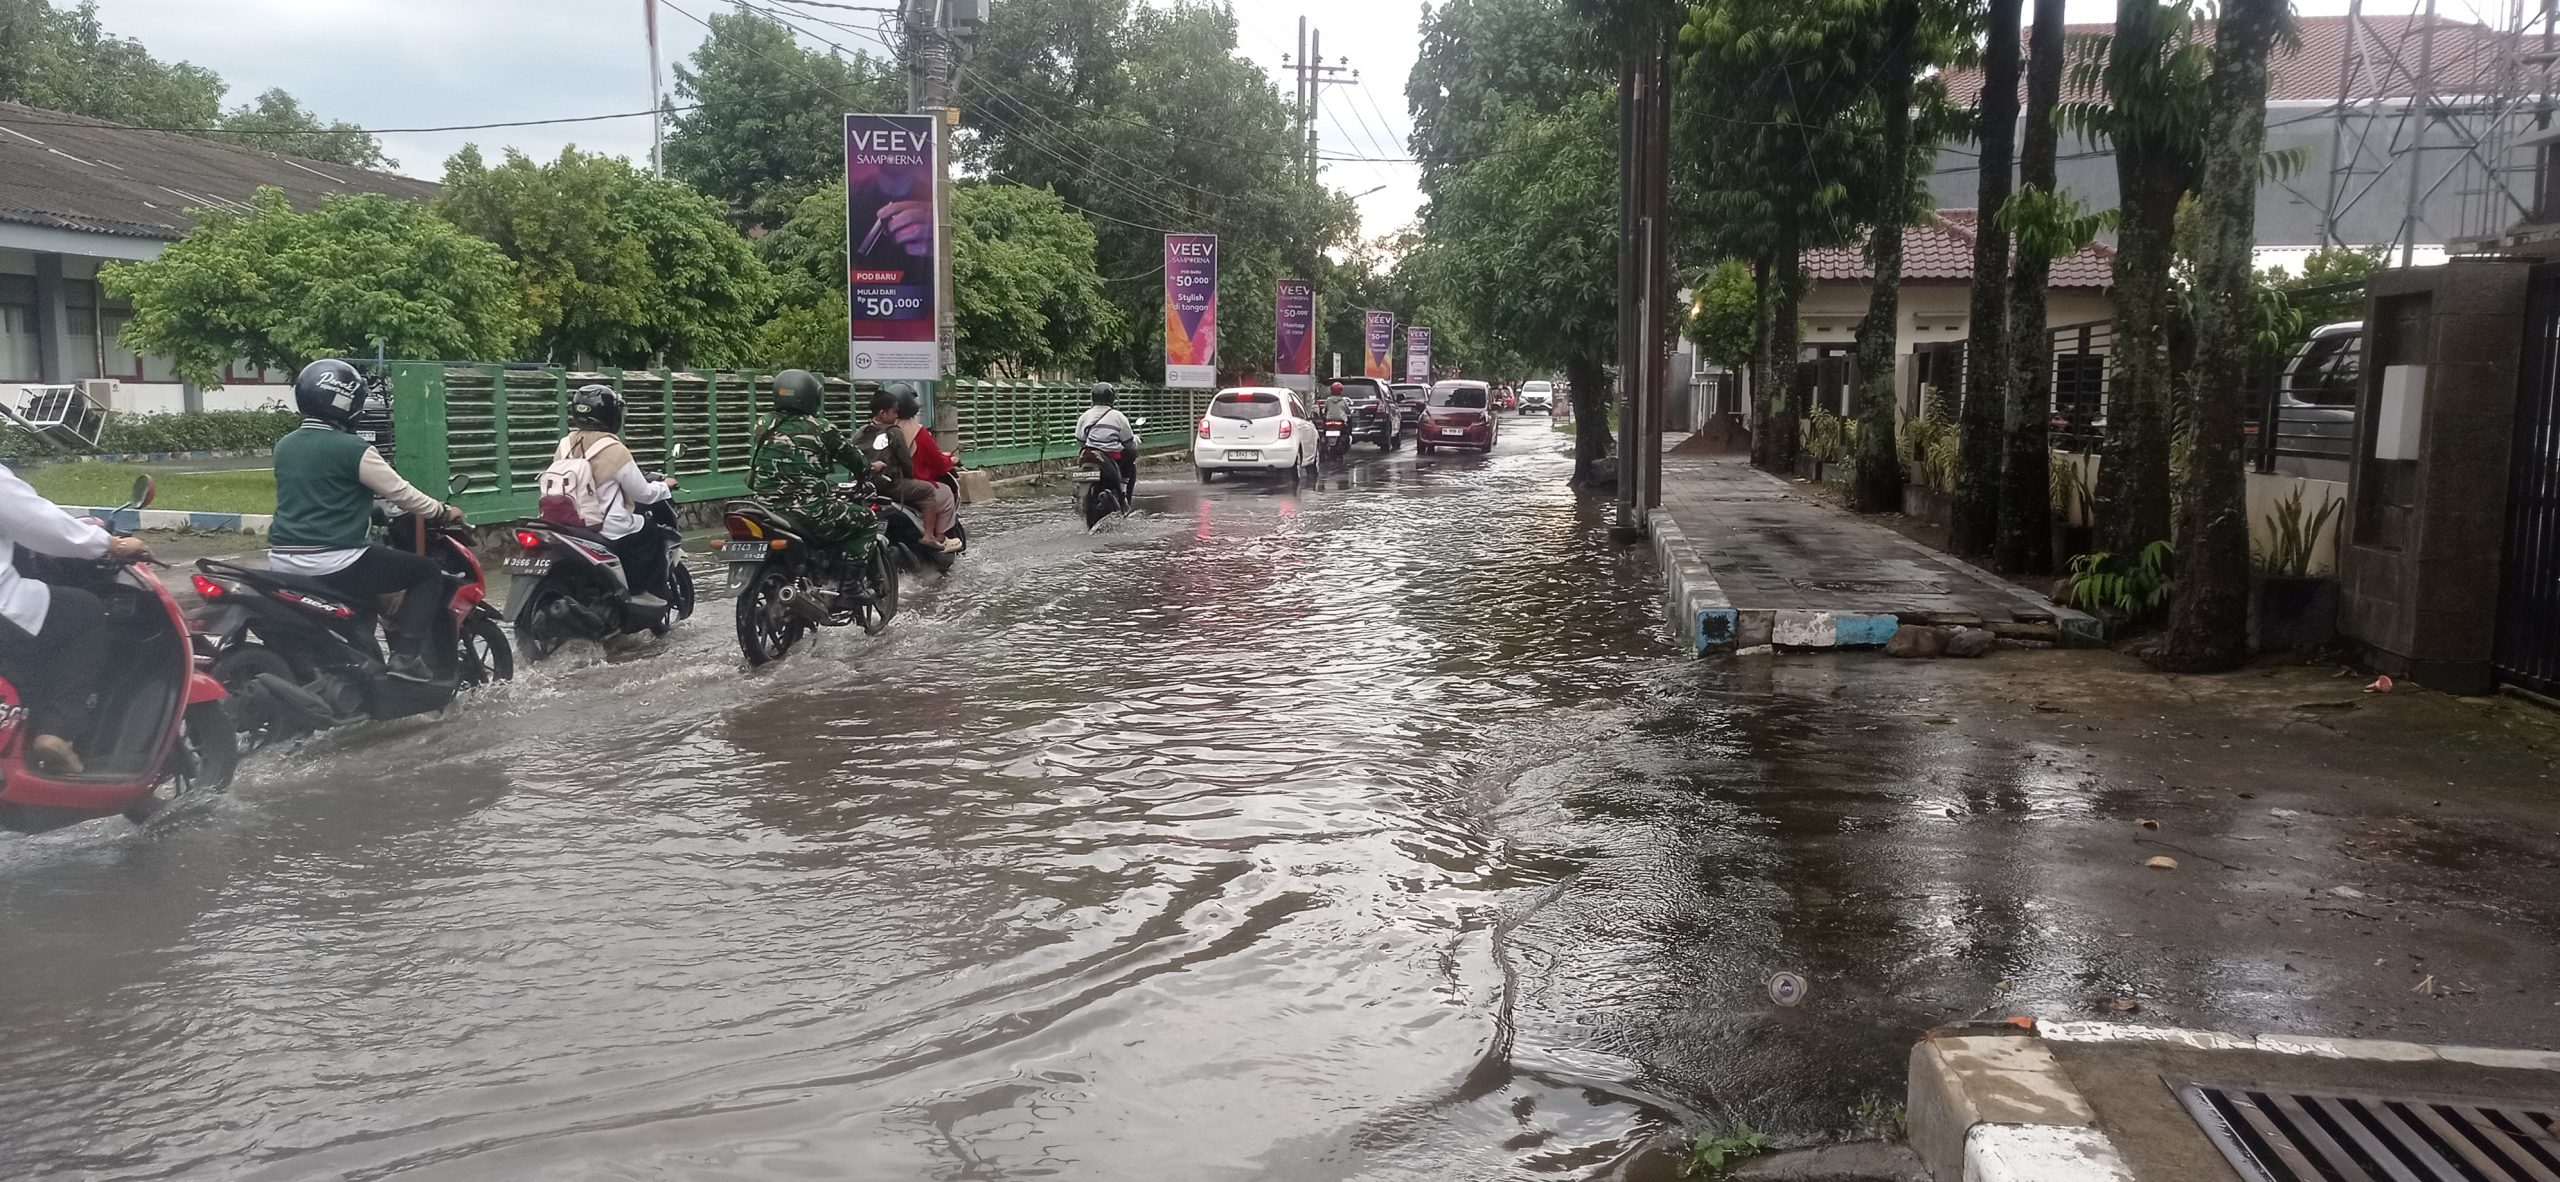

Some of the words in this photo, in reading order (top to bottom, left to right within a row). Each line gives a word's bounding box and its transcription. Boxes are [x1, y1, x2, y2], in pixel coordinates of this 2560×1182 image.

[851, 130, 928, 152] VEEV
[857, 154, 923, 165] SAMPOERNA
[1170, 243, 1213, 256] VEEV
[1280, 286, 1310, 295] VEEV
[1178, 293, 1204, 302] Stylish
[1182, 304, 1208, 313] tangan
[1369, 316, 1391, 324] VEEV
[503, 557, 510, 566] N
[534, 559, 551, 567] ACC
